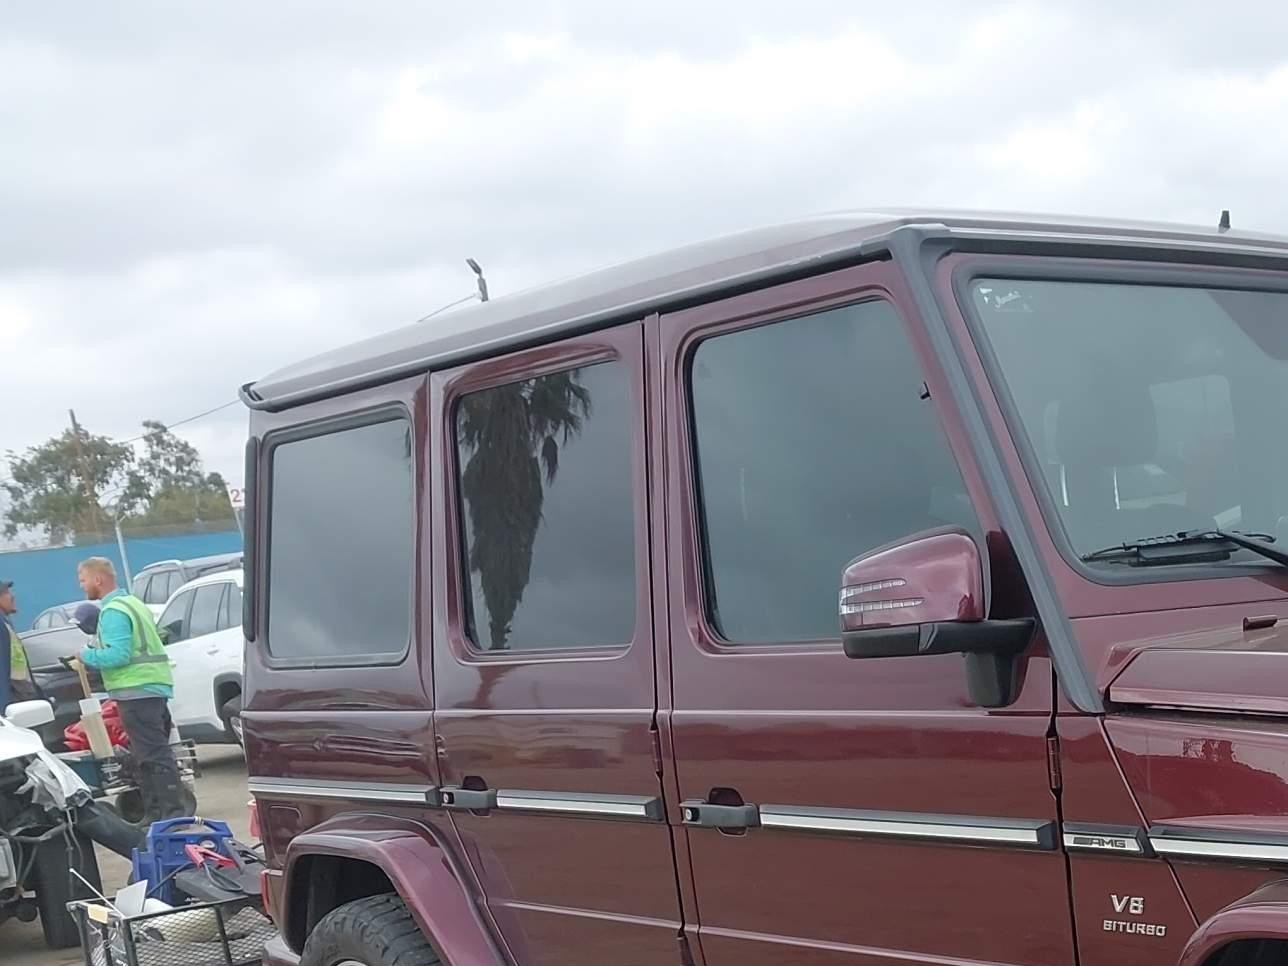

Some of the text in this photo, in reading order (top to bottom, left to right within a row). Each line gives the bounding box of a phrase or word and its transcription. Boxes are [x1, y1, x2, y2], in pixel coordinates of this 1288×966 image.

[1088, 838, 1126, 848] AMG
[1110, 894, 1145, 915] V8
[1103, 919, 1167, 937] BITURBO
